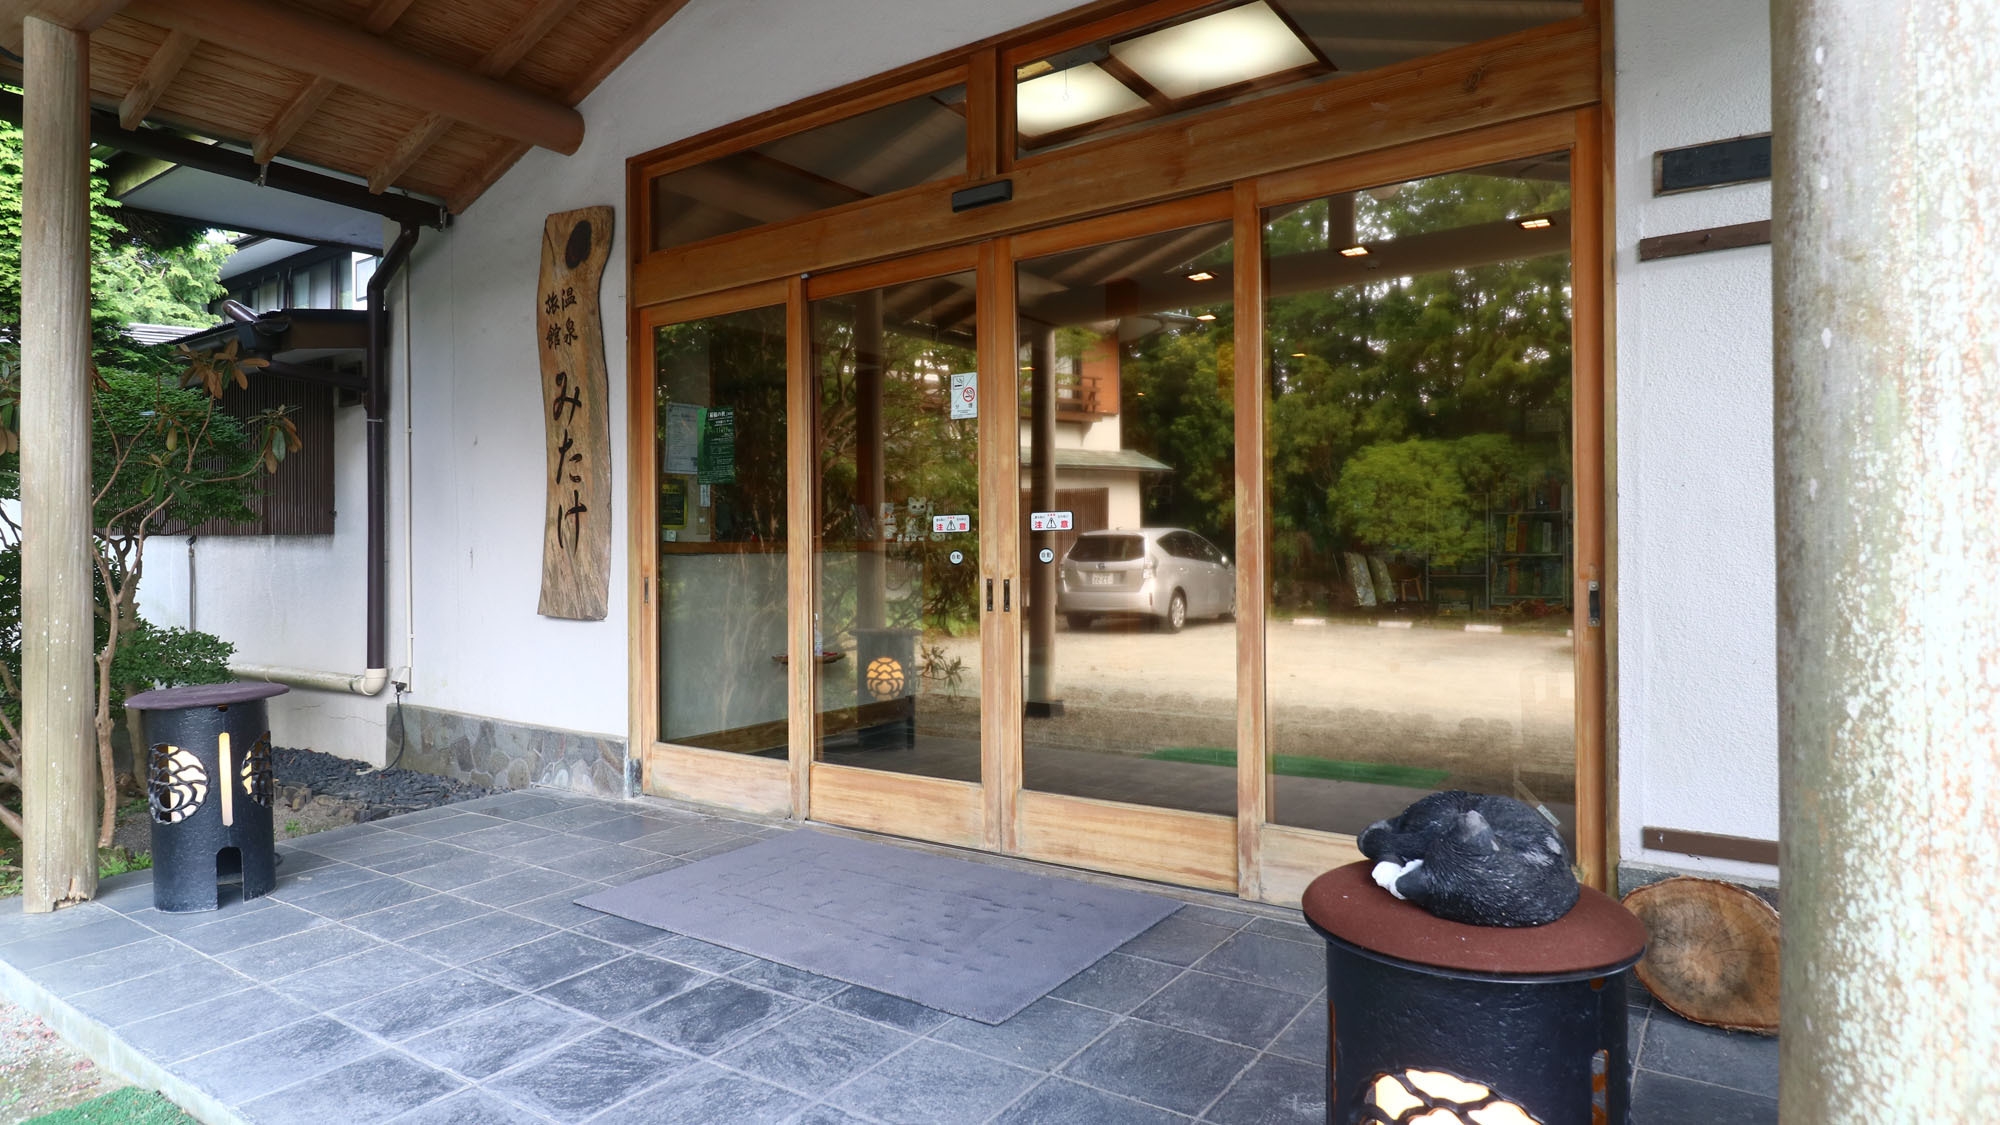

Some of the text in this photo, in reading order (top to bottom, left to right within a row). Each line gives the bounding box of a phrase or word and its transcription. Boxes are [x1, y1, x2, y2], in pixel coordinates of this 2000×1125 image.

[545, 291, 561, 350] 旅館
[562, 286, 578, 346] 温泉
[553, 371, 588, 558] みたけ
